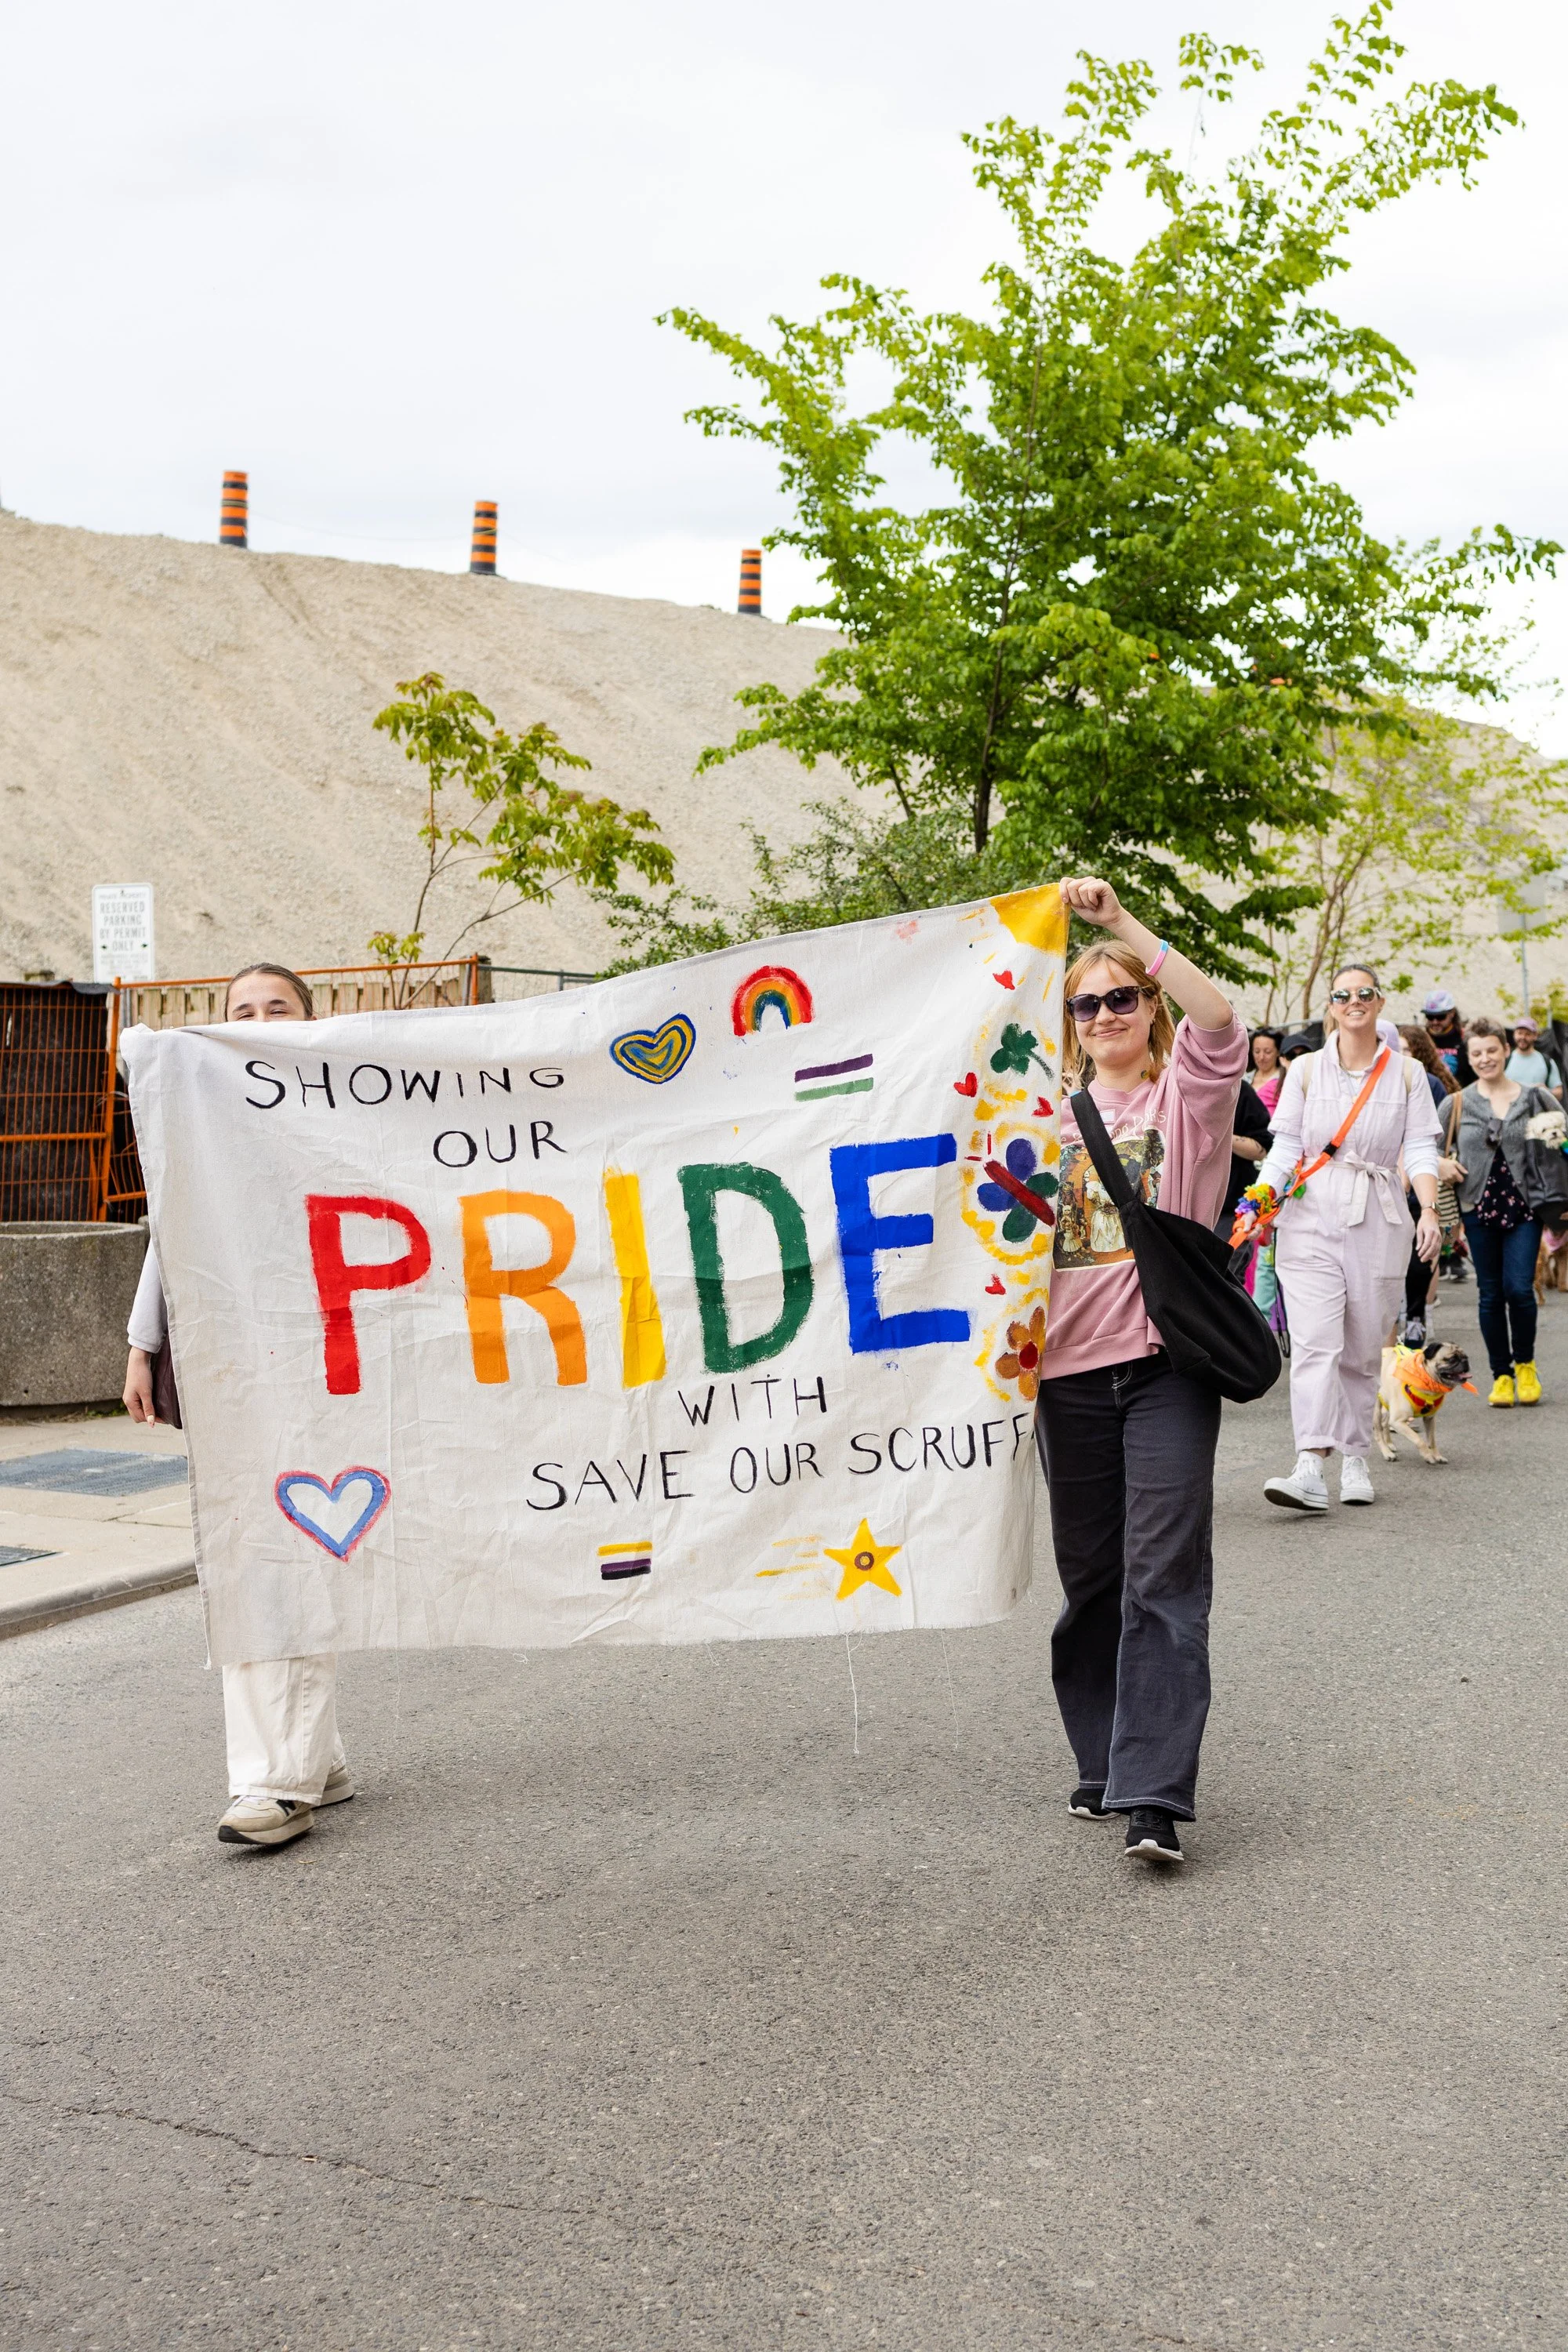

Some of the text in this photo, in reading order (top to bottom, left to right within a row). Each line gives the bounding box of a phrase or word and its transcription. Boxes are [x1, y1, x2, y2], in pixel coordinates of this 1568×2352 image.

[100, 901, 145, 914] RESERVED
[103, 914, 142, 926] PARKING
[100, 927, 147, 939] BY PERMIT
[112, 940, 134, 952] ONLY
[245, 1060, 564, 1109] SHOWING
[434, 1120, 568, 1167] OUR
[304, 1132, 971, 1396] PRIDE
[678, 1375, 827, 1427] WITH
[526, 1450, 695, 1511] SAVE
[730, 1443, 824, 1494] OUR
